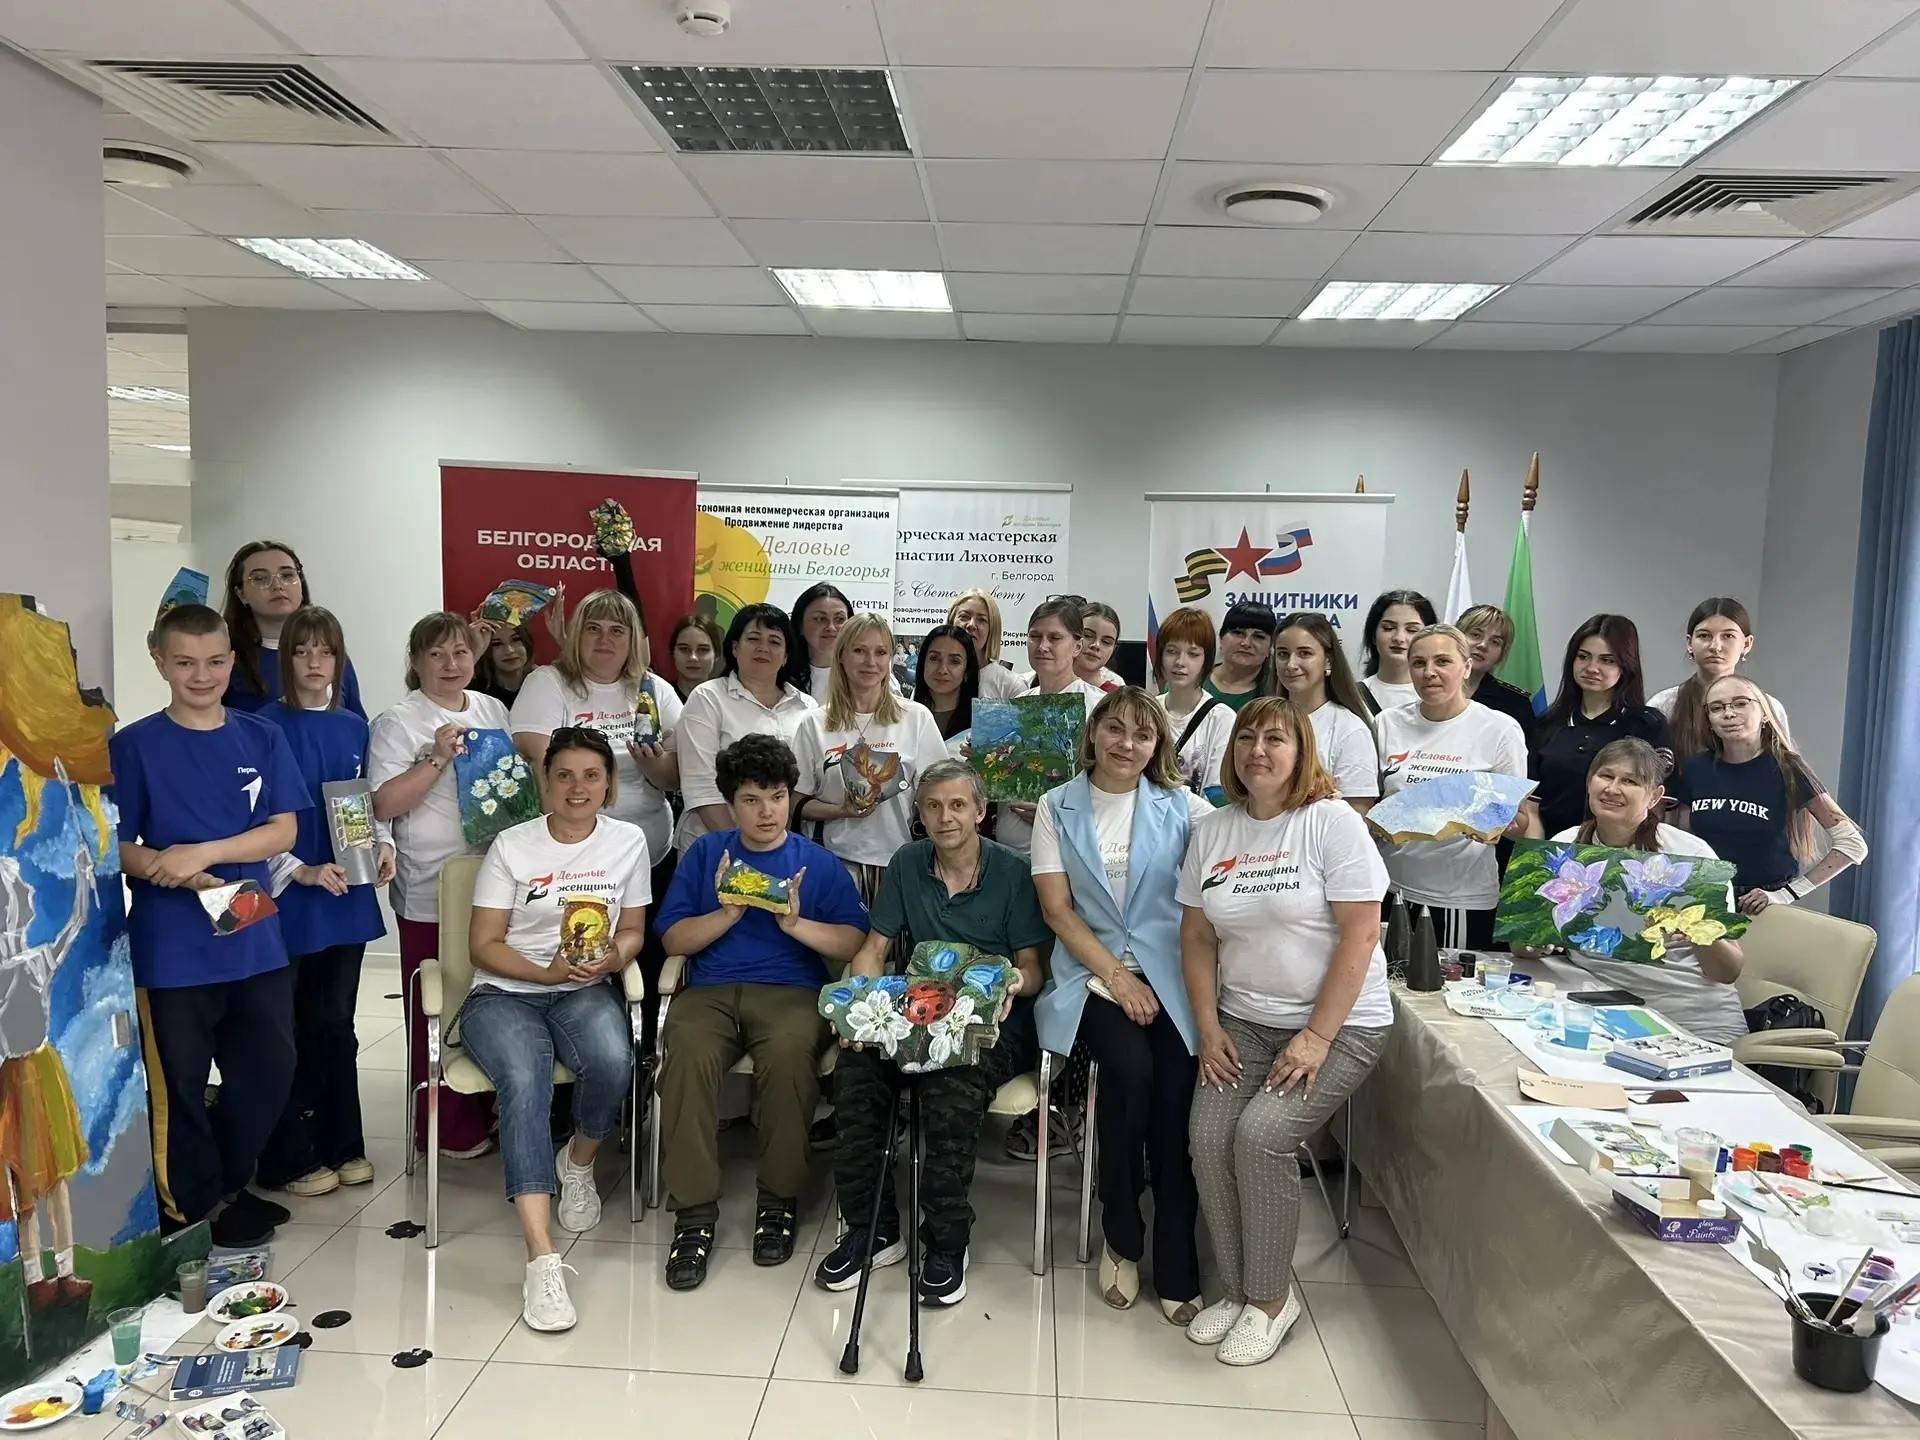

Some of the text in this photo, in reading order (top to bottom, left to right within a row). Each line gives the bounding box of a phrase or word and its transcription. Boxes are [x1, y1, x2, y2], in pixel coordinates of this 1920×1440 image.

[697, 504, 890, 520] тономная некоммерческая организация
[724, 516, 843, 531] Продвижение лидерства
[477, 529, 662, 552] БЕЛГОРОДАЯ
[968, 531, 1057, 545] мастерская
[758, 535, 850, 557] Деловые
[958, 550, 1054, 564] Ляховченко
[718, 559, 890, 581] женщины Белогорья
[1001, 570, 1055, 582] Белгород
[1225, 592, 1359, 609] ЗАЩИТНИКИ
[1411, 750, 1463, 762] Деловые
[1691, 798, 1769, 821] NEW YORK
[557, 869, 606, 880] Деловые
[1236, 865, 1299, 879] женщины
[557, 883, 616, 893] женщины
[1232, 881, 1300, 895] Белогорья
